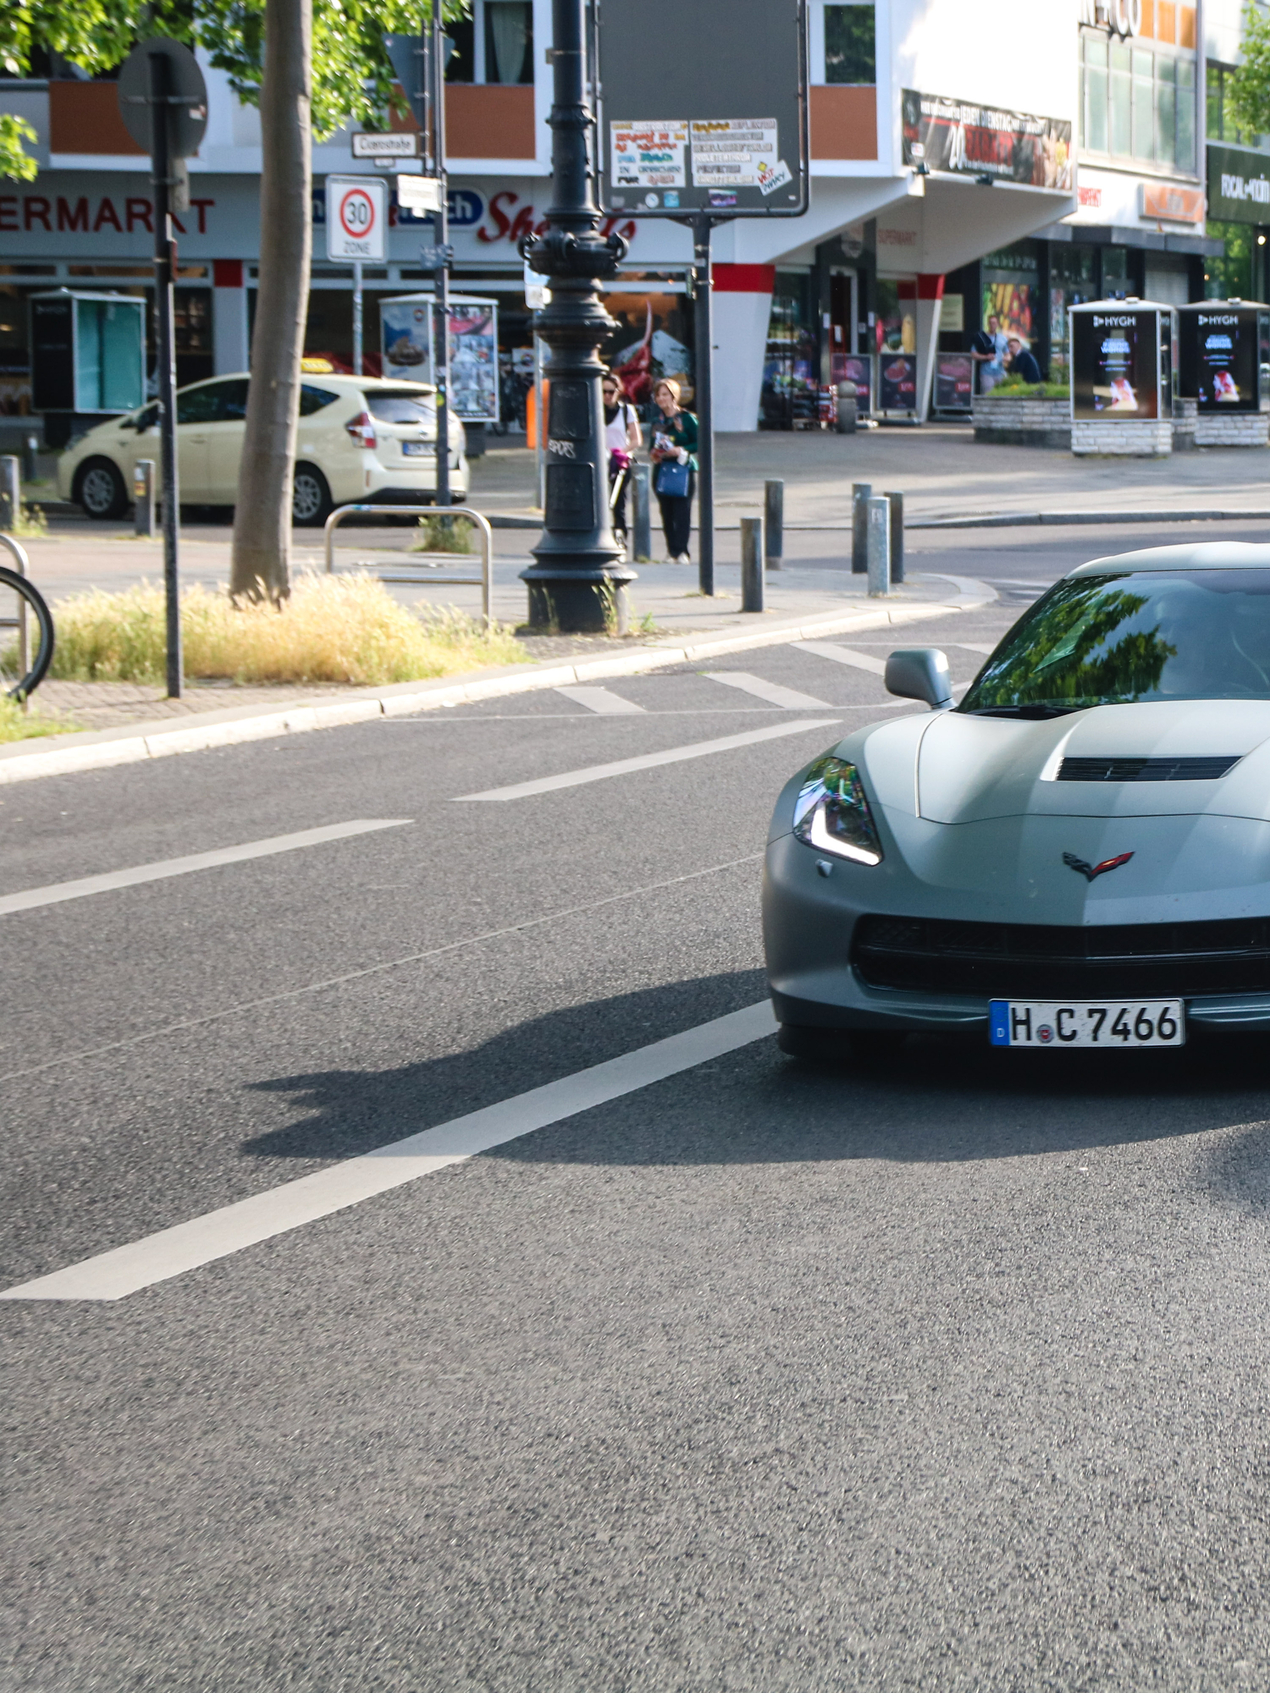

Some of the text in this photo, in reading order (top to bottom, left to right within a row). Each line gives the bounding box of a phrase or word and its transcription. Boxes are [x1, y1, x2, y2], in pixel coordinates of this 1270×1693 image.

[0, 197, 215, 234] ERMART
[345, 202, 368, 225] 30
[343, 241, 371, 255] ZONE
[1104, 316, 1136, 327] HYGH
[1208, 315, 1238, 325] HYGH
[1011, 1007, 1032, 1041] H
[1087, 1007, 1177, 1042] 7466
[996, 1027, 1005, 1038] D
